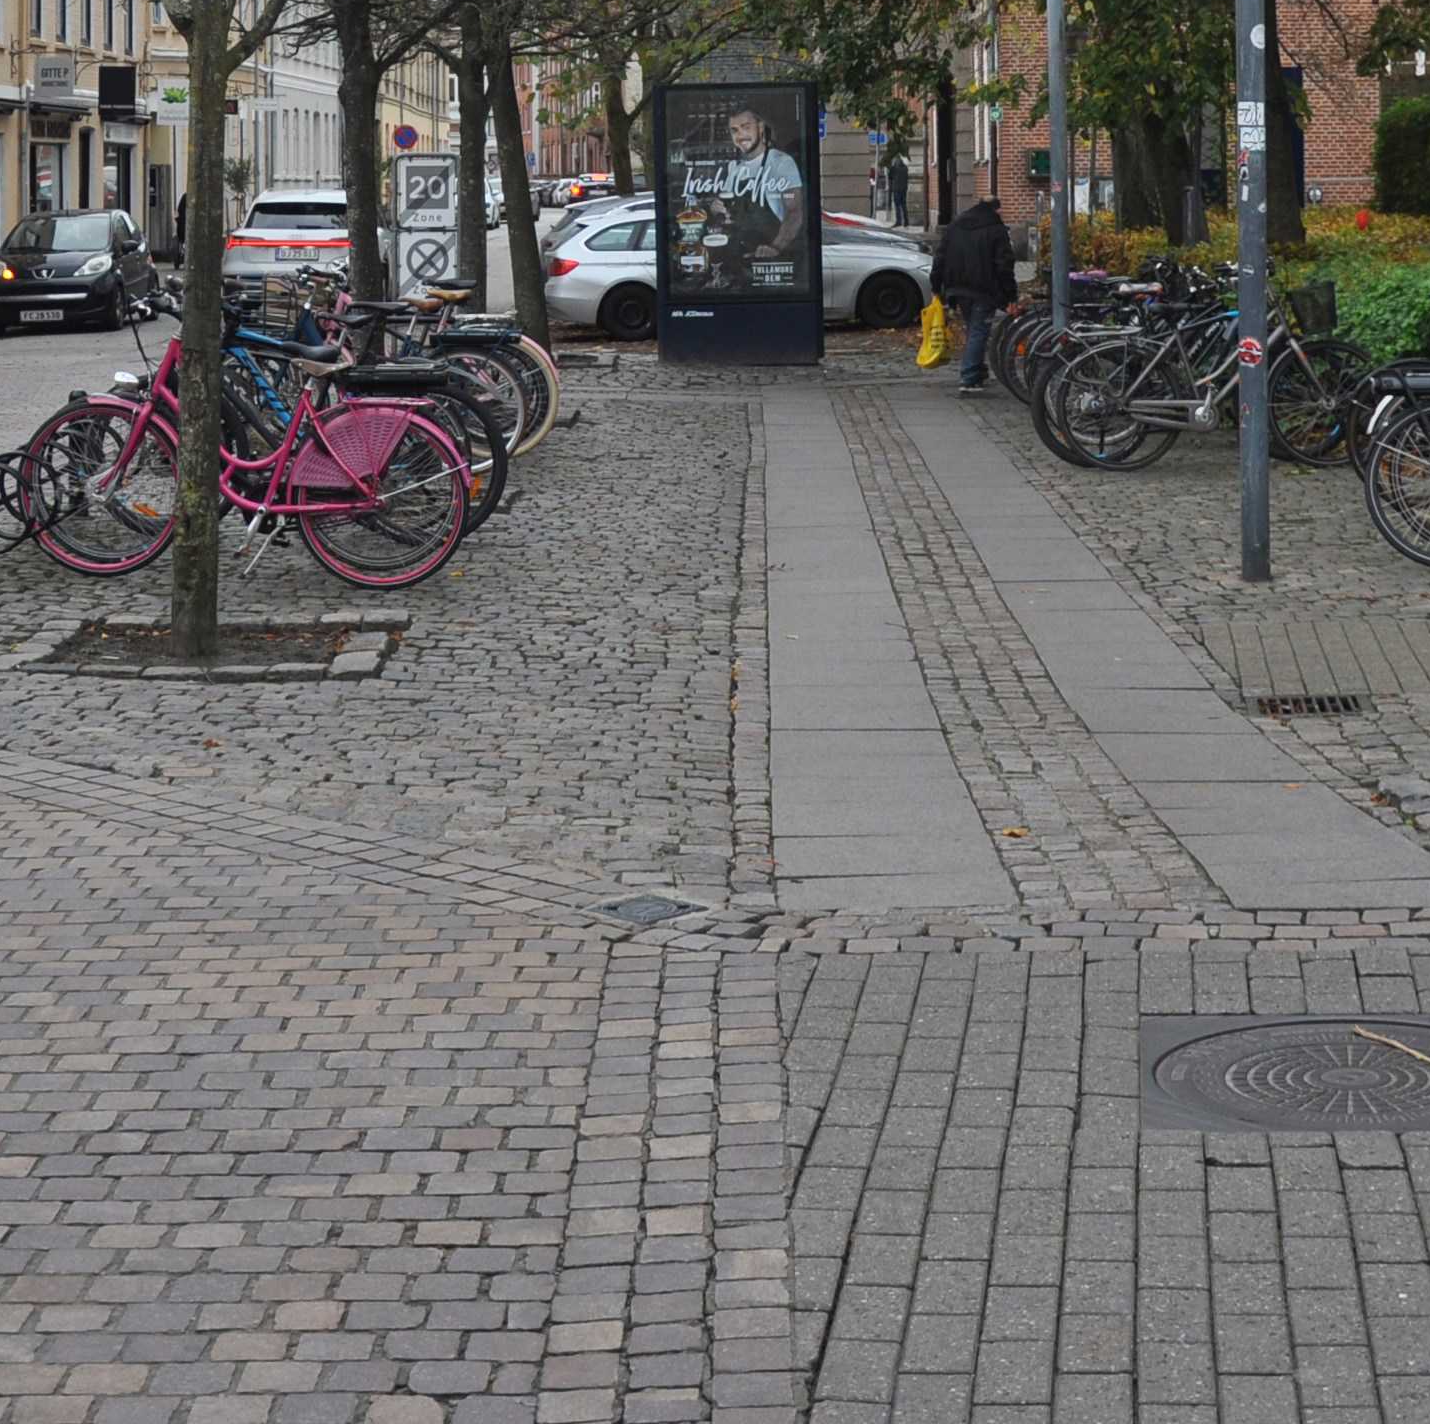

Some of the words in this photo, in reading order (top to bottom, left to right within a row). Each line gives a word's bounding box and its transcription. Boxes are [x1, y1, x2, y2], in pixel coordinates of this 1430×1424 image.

[409, 175, 446, 200] 20
[681, 166, 725, 198] Irish
[734, 165, 790, 207] Coffee
[413, 213, 443, 222] Zone
[752, 265, 794, 274] TULLAMORE
